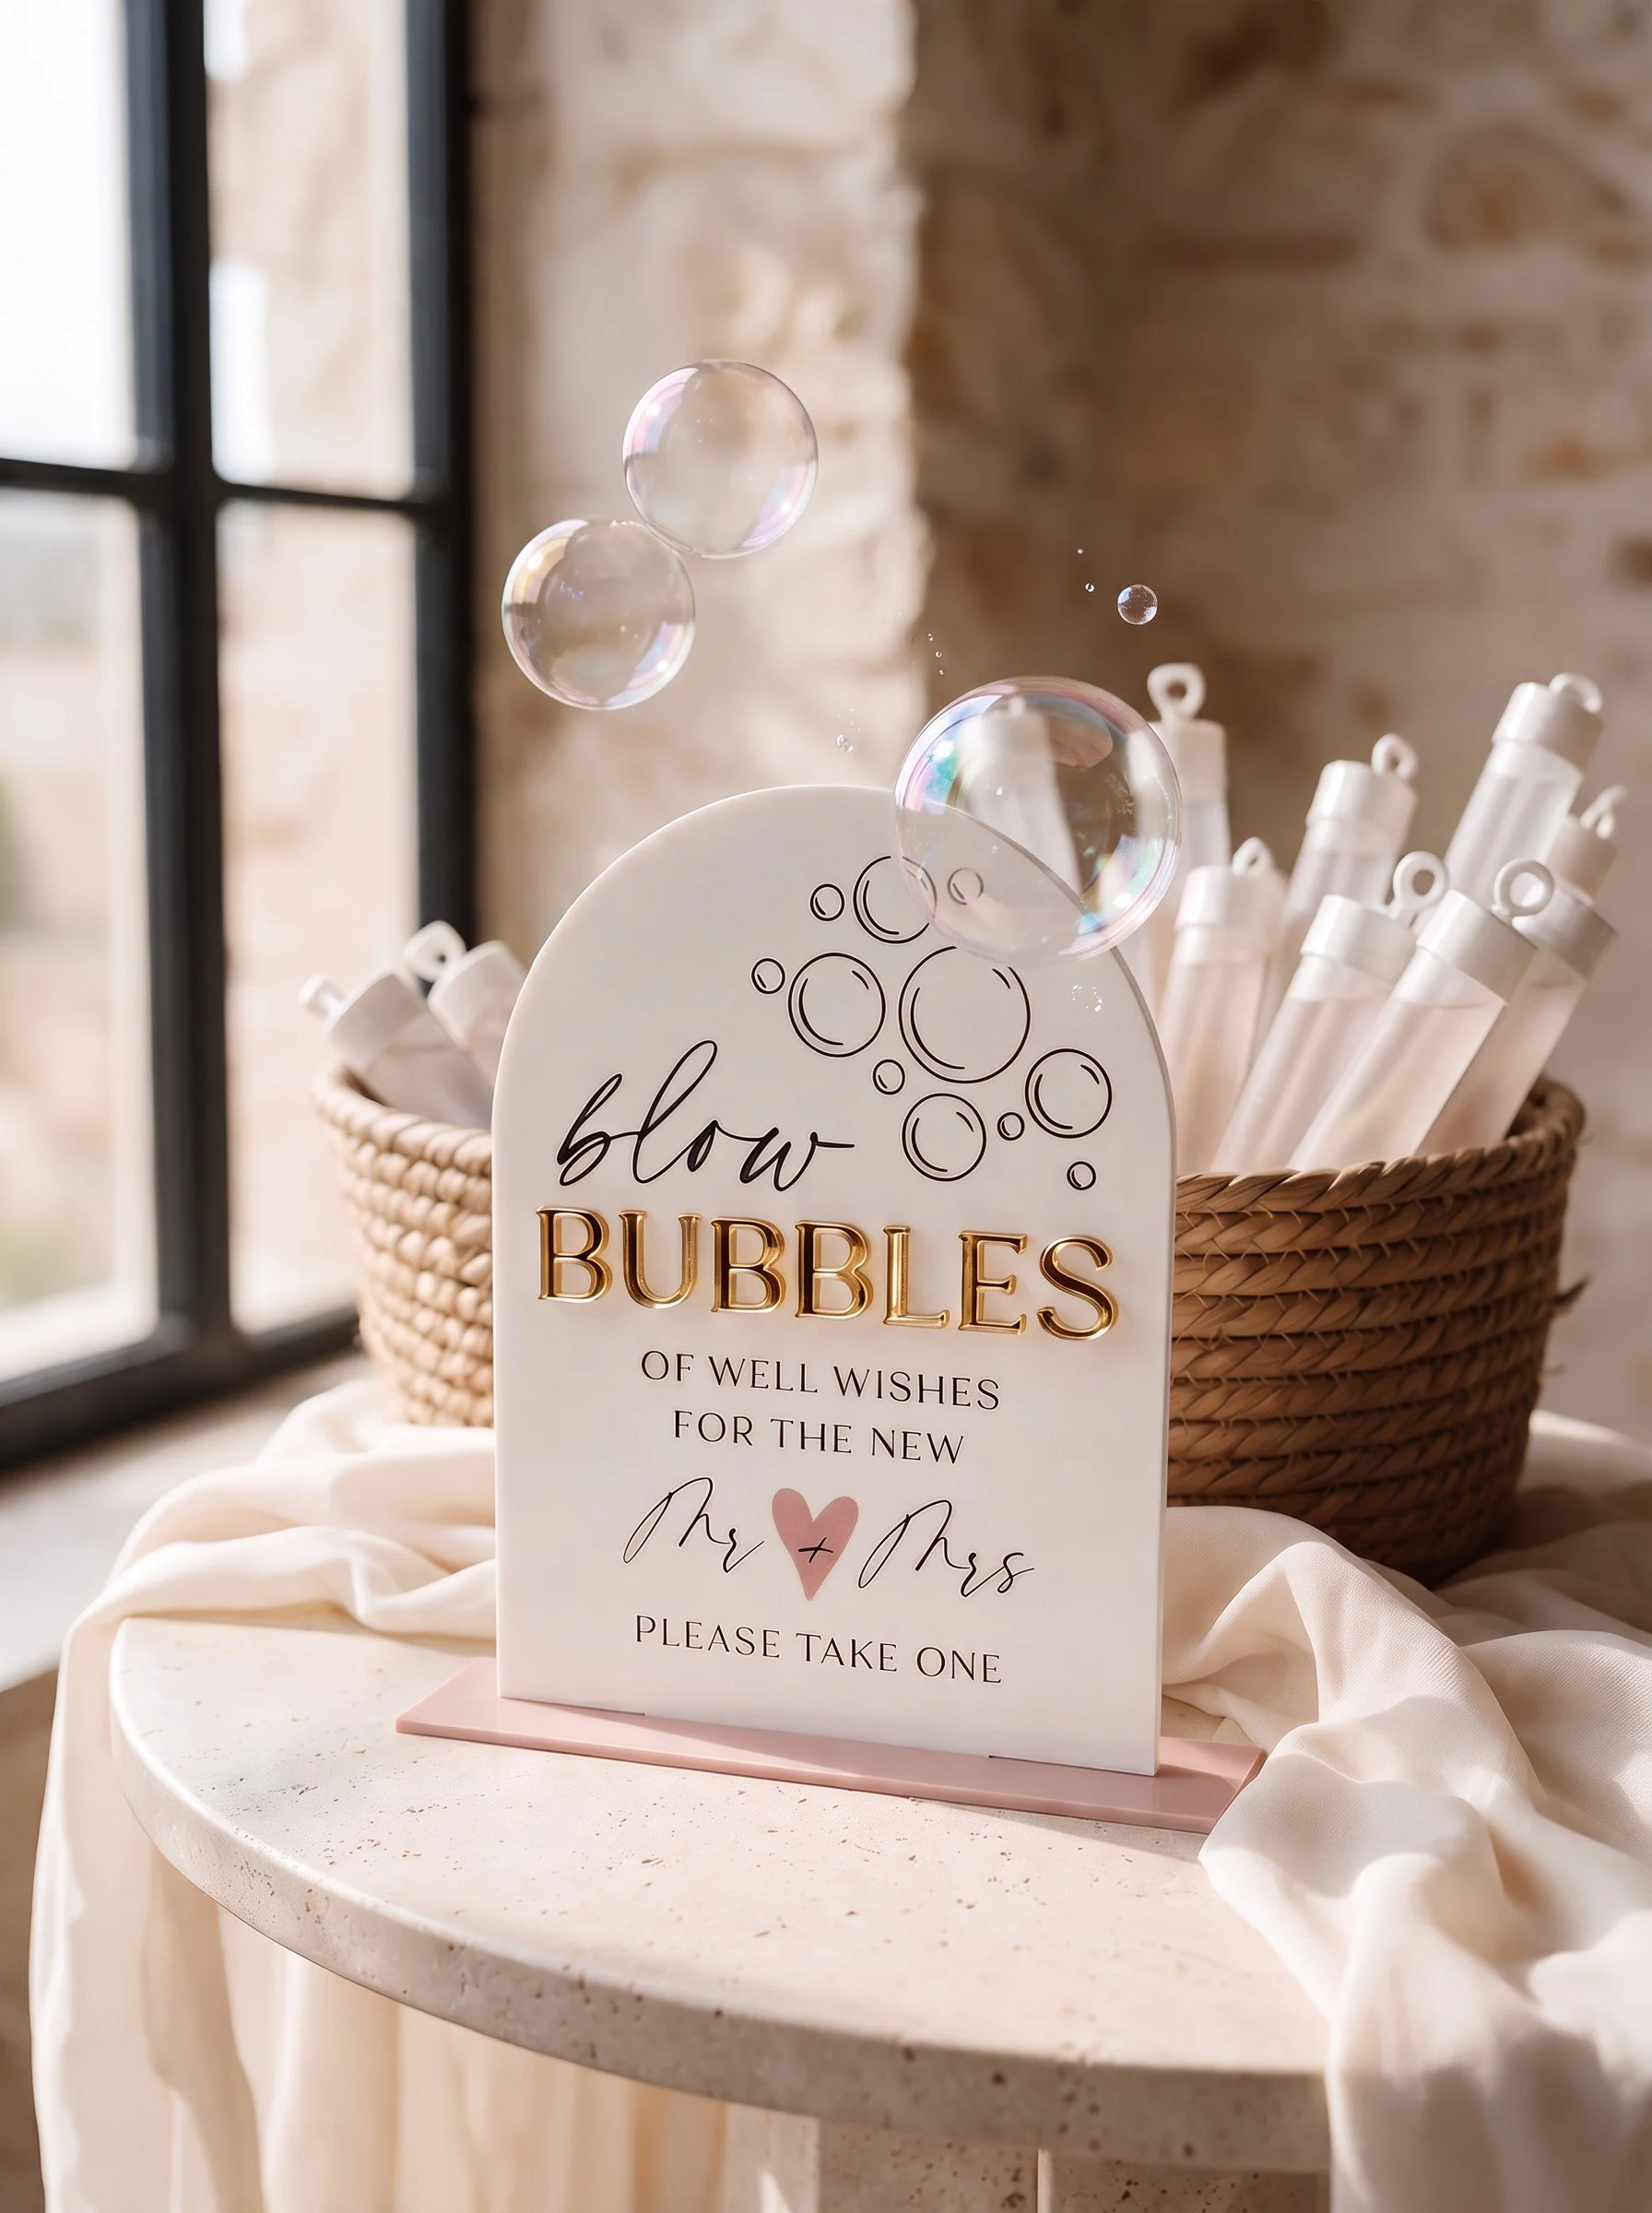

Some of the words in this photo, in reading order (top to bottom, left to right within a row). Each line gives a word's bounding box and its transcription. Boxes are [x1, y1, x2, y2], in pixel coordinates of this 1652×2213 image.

[557, 1040, 856, 1192] blow
[536, 1205, 1120, 1343] BUBBLES
[641, 1350, 695, 1382] OF
[708, 1356, 819, 1393] WELL
[832, 1366, 1000, 1411] WISHES
[674, 1410, 753, 1447] FOR
[770, 1418, 852, 1454] THE
[871, 1427, 964, 1464] NEW
[622, 1476, 765, 1574] Mr
[857, 1499, 1035, 1598] Mrs
[636, 1615, 781, 1659] PLEASE
[796, 1632, 899, 1673] TAKE
[916, 1646, 1003, 1684] ONE
